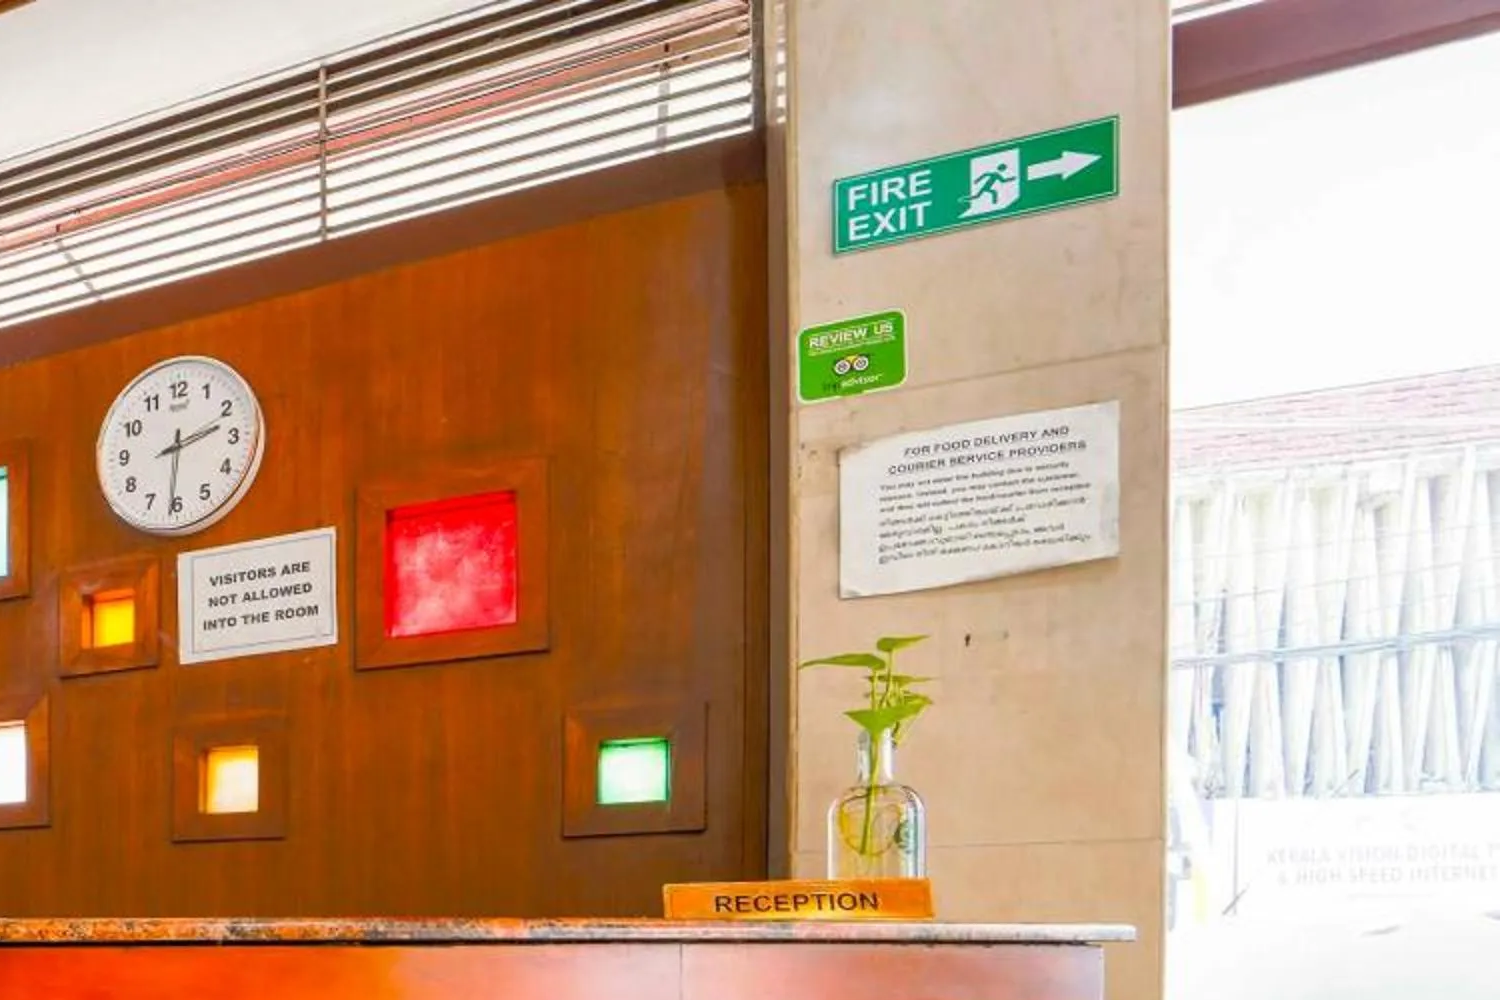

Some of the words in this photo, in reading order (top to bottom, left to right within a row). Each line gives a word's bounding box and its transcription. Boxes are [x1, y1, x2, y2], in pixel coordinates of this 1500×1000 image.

[848, 169, 932, 211] FIRE
[849, 200, 932, 241] EXIT
[809, 327, 867, 349] REVIEW
[170, 381, 188, 398] 12
[202, 384, 211, 400] 1
[144, 394, 160, 412] 11
[220, 400, 232, 417] 2
[124, 419, 142, 437] 10
[227, 427, 239, 444] 3
[904, 445, 931, 457] FOR
[934, 440, 971, 453] FOOD
[974, 431, 1037, 447] DELIVERY
[1041, 426, 1070, 438] AND
[119, 449, 130, 466] 9
[219, 458, 231, 474] 4
[888, 458, 945, 475] COURIER
[950, 450, 1005, 466] SERVICE
[1009, 440, 1087, 457] PROVIDERS
[125, 476, 136, 492] 8
[200, 483, 211, 500] 5
[144, 493, 156, 510] 7
[172, 496, 183, 513] 6
[209, 566, 277, 587] VISITORS
[281, 561, 311, 576] ARE
[208, 593, 238, 608] NOT
[242, 582, 313, 602] ALLOWED
[203, 617, 237, 631] INTO
[241, 611, 270, 625] THE
[275, 604, 319, 621] ROOM
[1348, 866, 1403, 884] SPEED
[714, 892, 879, 913] RECEPTION
